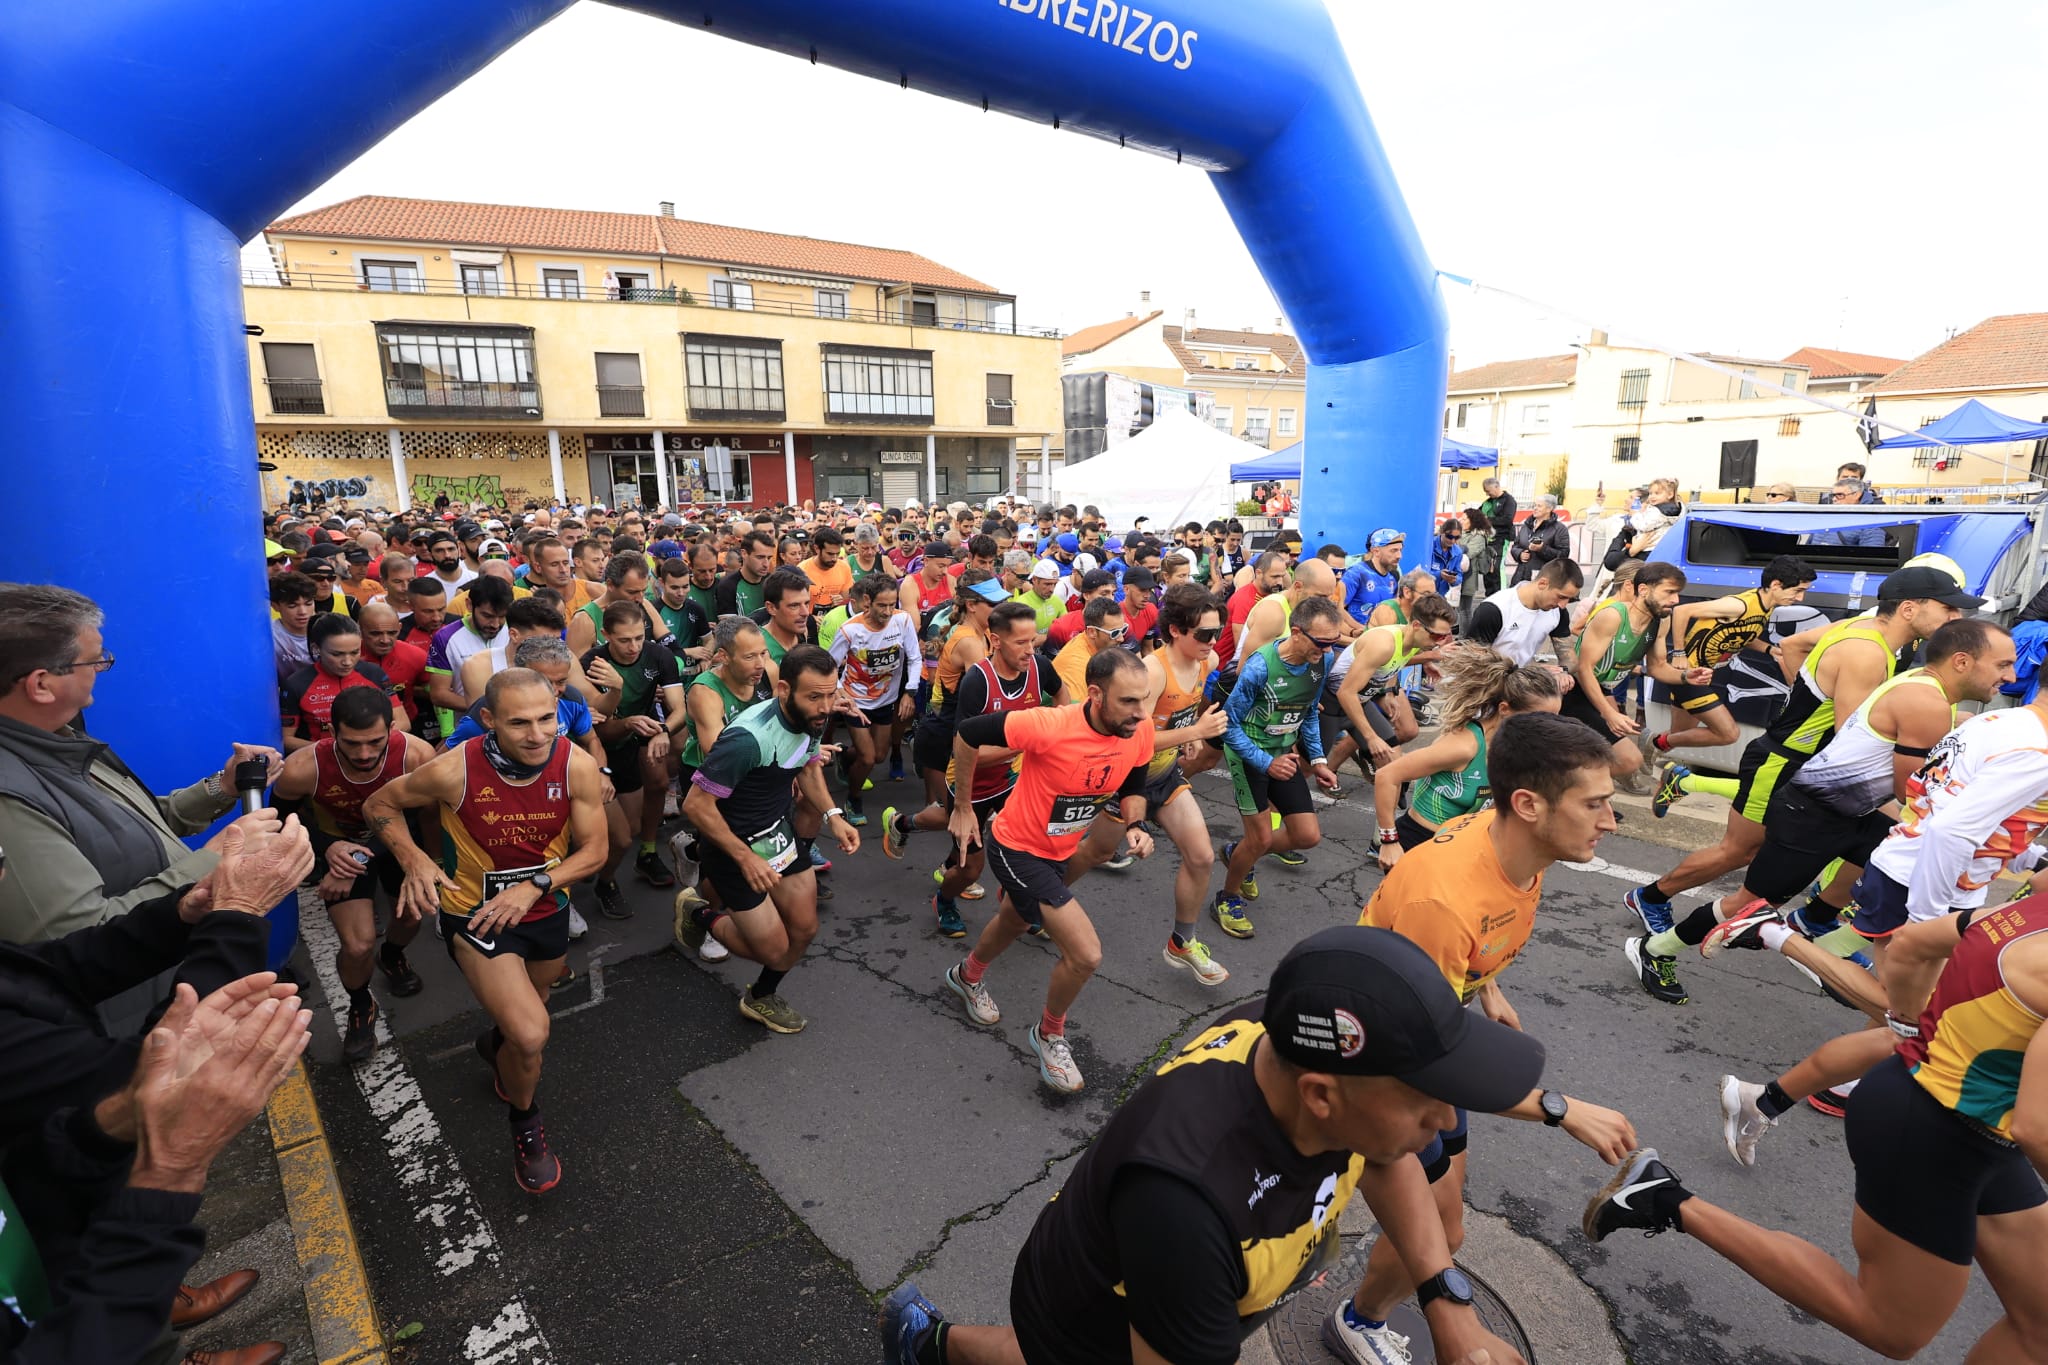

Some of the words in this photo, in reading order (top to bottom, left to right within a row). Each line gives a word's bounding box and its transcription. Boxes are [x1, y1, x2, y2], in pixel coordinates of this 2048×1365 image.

[998, 0, 1198, 71] BRERIZOS
[612, 436, 742, 449] KISCAR
[874, 654, 895, 666] 248
[1283, 712, 1301, 723] 93
[502, 813, 526, 821] CAJA
[528, 811, 557, 820] RURAL
[1064, 805, 1096, 820] 512
[501, 826, 537, 837] VINO
[488, 838, 507, 847] DE
[511, 833, 549, 846] TORO
[769, 831, 788, 853] 79
[1990, 912, 2005, 924] DE
[1998, 919, 2017, 937] TORO
[2007, 910, 2026, 927] VINO
[1306, 1026, 1335, 1039] CARRERA
[1292, 1035, 1318, 1049] POPULAR
